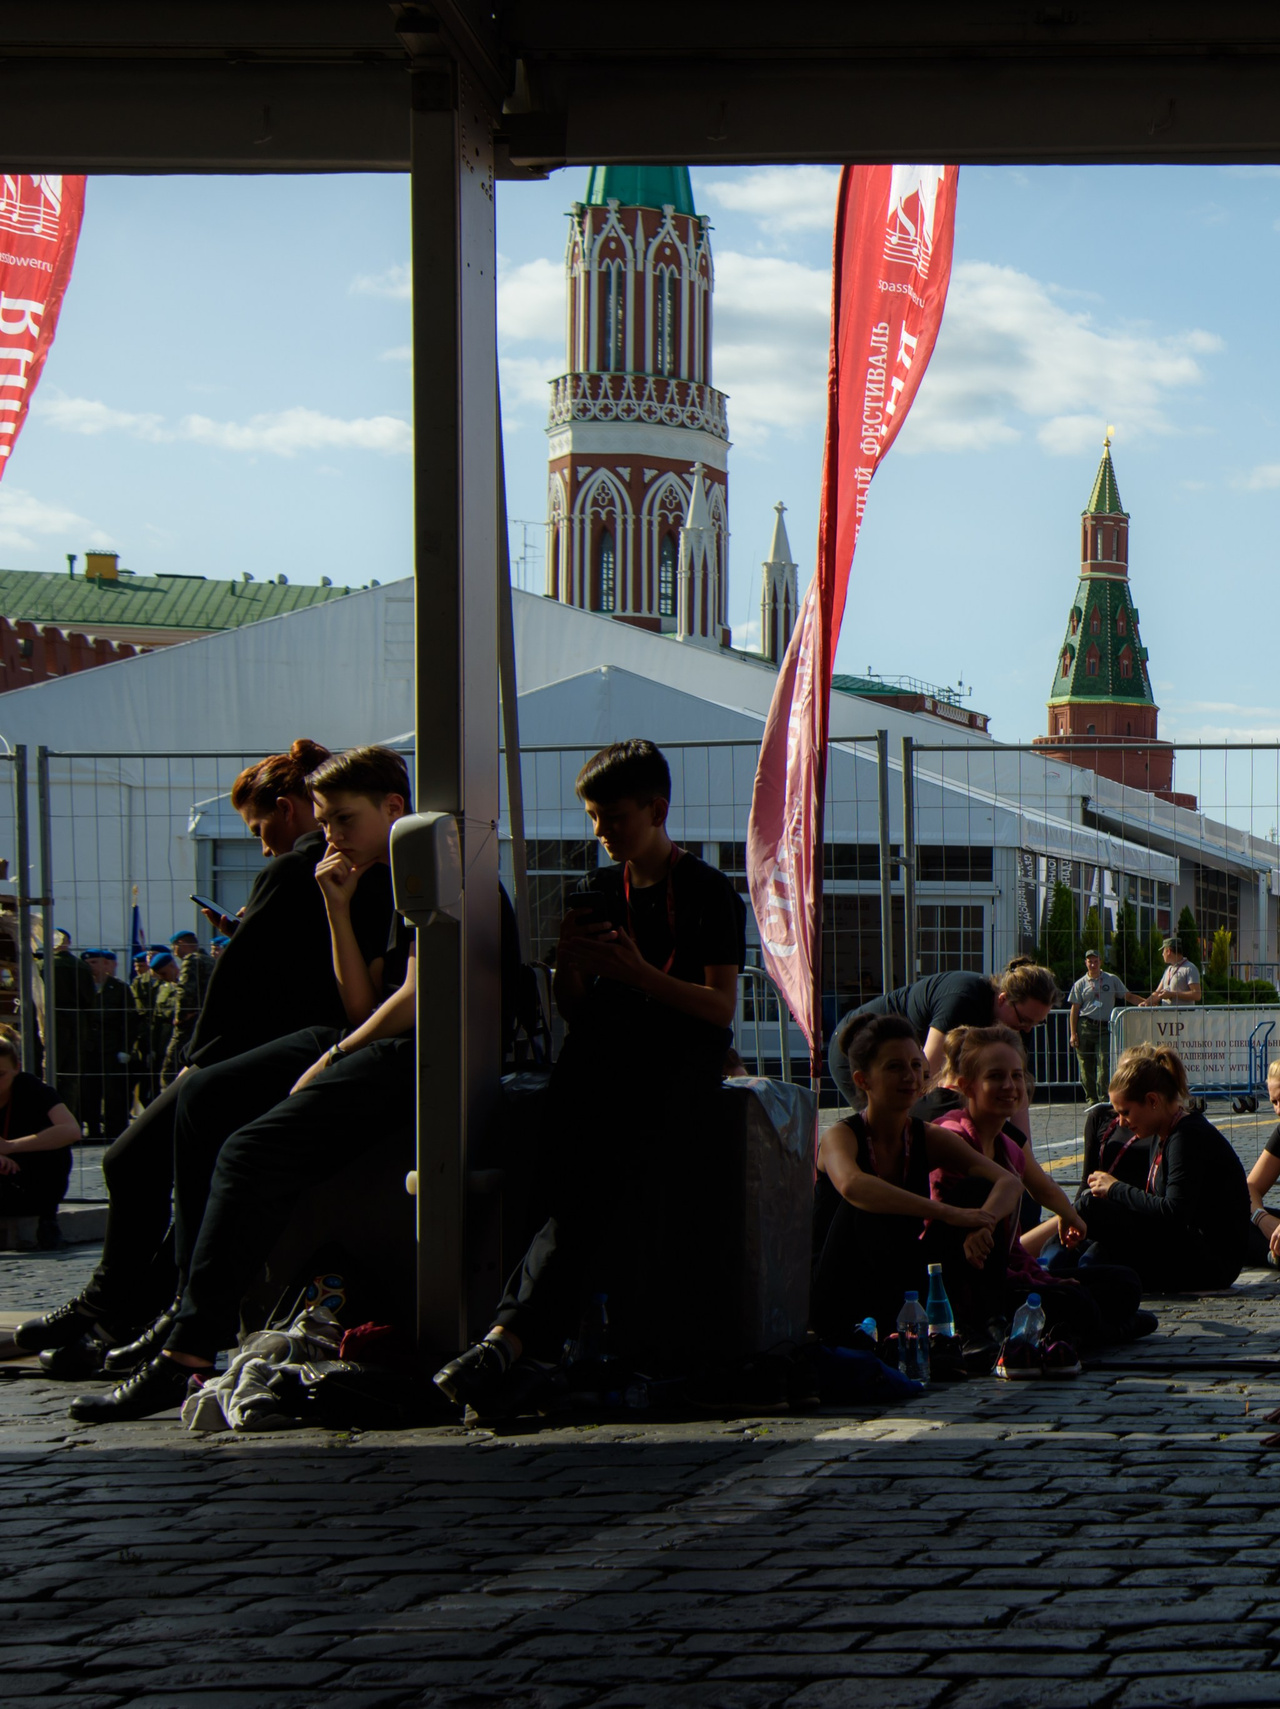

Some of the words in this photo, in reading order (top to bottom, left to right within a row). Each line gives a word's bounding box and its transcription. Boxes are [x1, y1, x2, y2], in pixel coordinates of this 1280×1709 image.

[859, 321, 890, 456] ФЕСТИВАЛЬ
[1156, 1022, 1185, 1037] VIP
[1181, 1040, 1213, 1048] ТОЛЬКО
